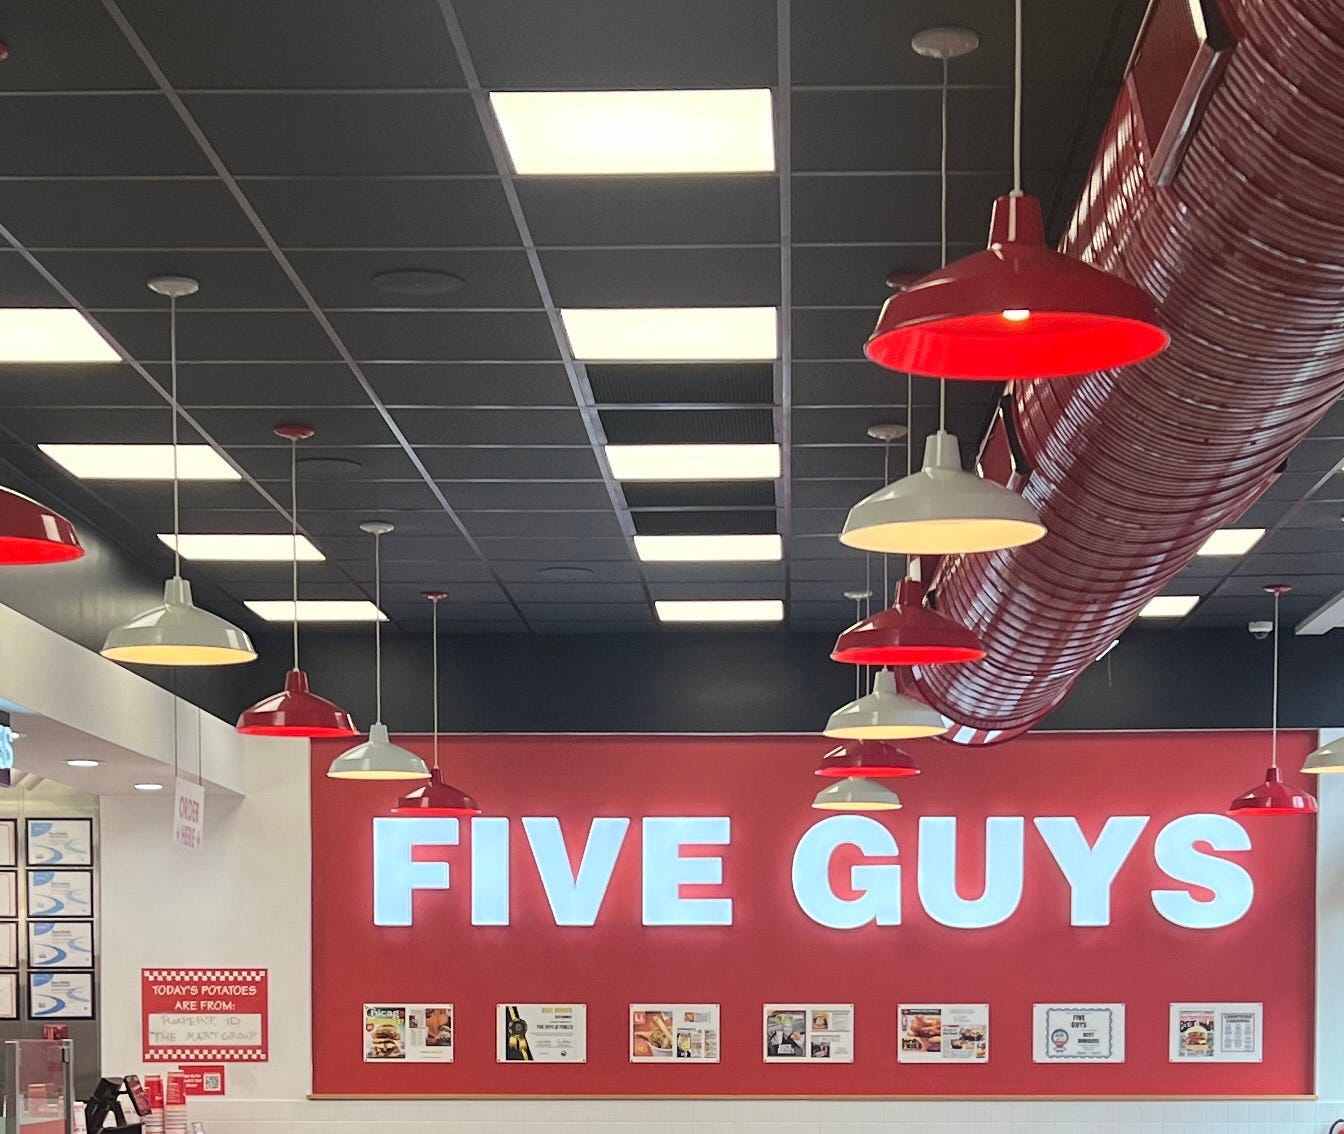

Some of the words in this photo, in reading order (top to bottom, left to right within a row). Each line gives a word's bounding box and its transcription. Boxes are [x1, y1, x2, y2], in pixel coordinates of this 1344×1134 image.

[179, 795, 199, 822] ORDER
[373, 815, 733, 926] FIVE
[792, 813, 1254, 929] GUYS
[152, 985, 198, 996] TODAY'S
[201, 985, 257, 996] POTATOES
[175, 1001, 198, 1010] ARE
[200, 1001, 236, 1011] FROM:
[150, 1032, 176, 1042] THE
